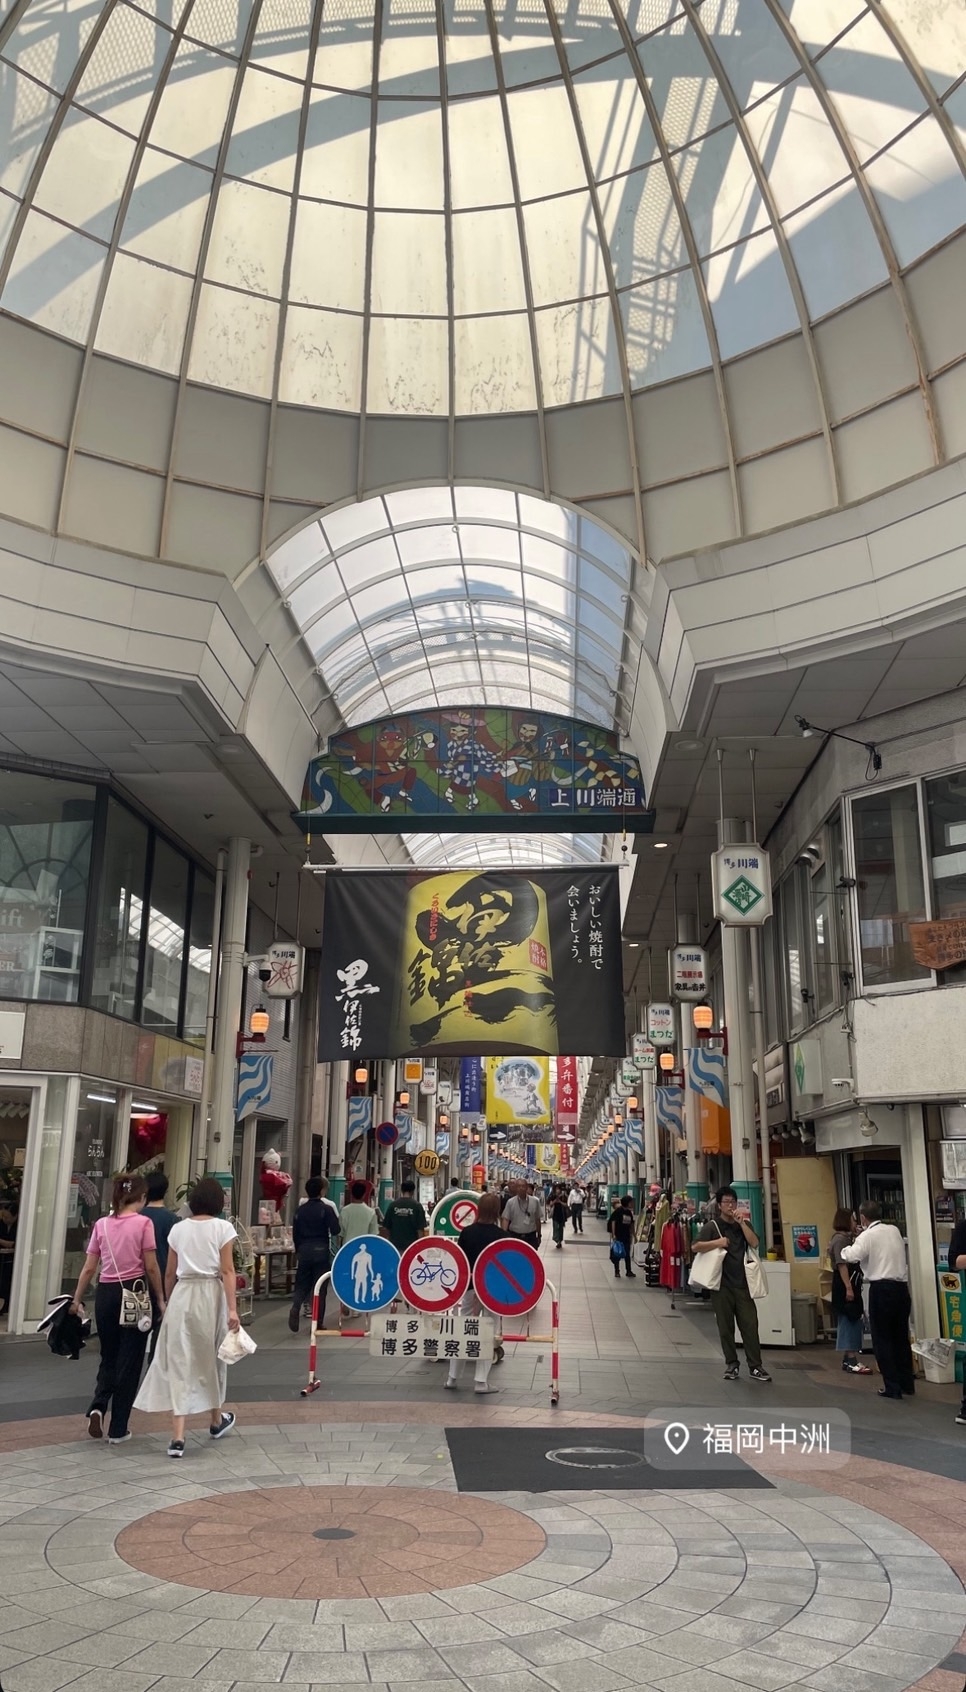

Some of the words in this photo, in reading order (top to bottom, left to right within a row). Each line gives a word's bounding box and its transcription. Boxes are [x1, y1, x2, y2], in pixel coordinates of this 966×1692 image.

[551, 781, 636, 807] 上川端通
[566, 885, 583, 964] 会いましょう。
[588, 885, 604, 970] おいしい焼酎で
[650, 1030, 673, 1039] まつだ
[418, 1155, 437, 1170] 100
[385, 1318, 480, 1336] 博多川端
[949, 1295, 963, 1338] 宅急便
[381, 1338, 481, 1358] 博多警察署
